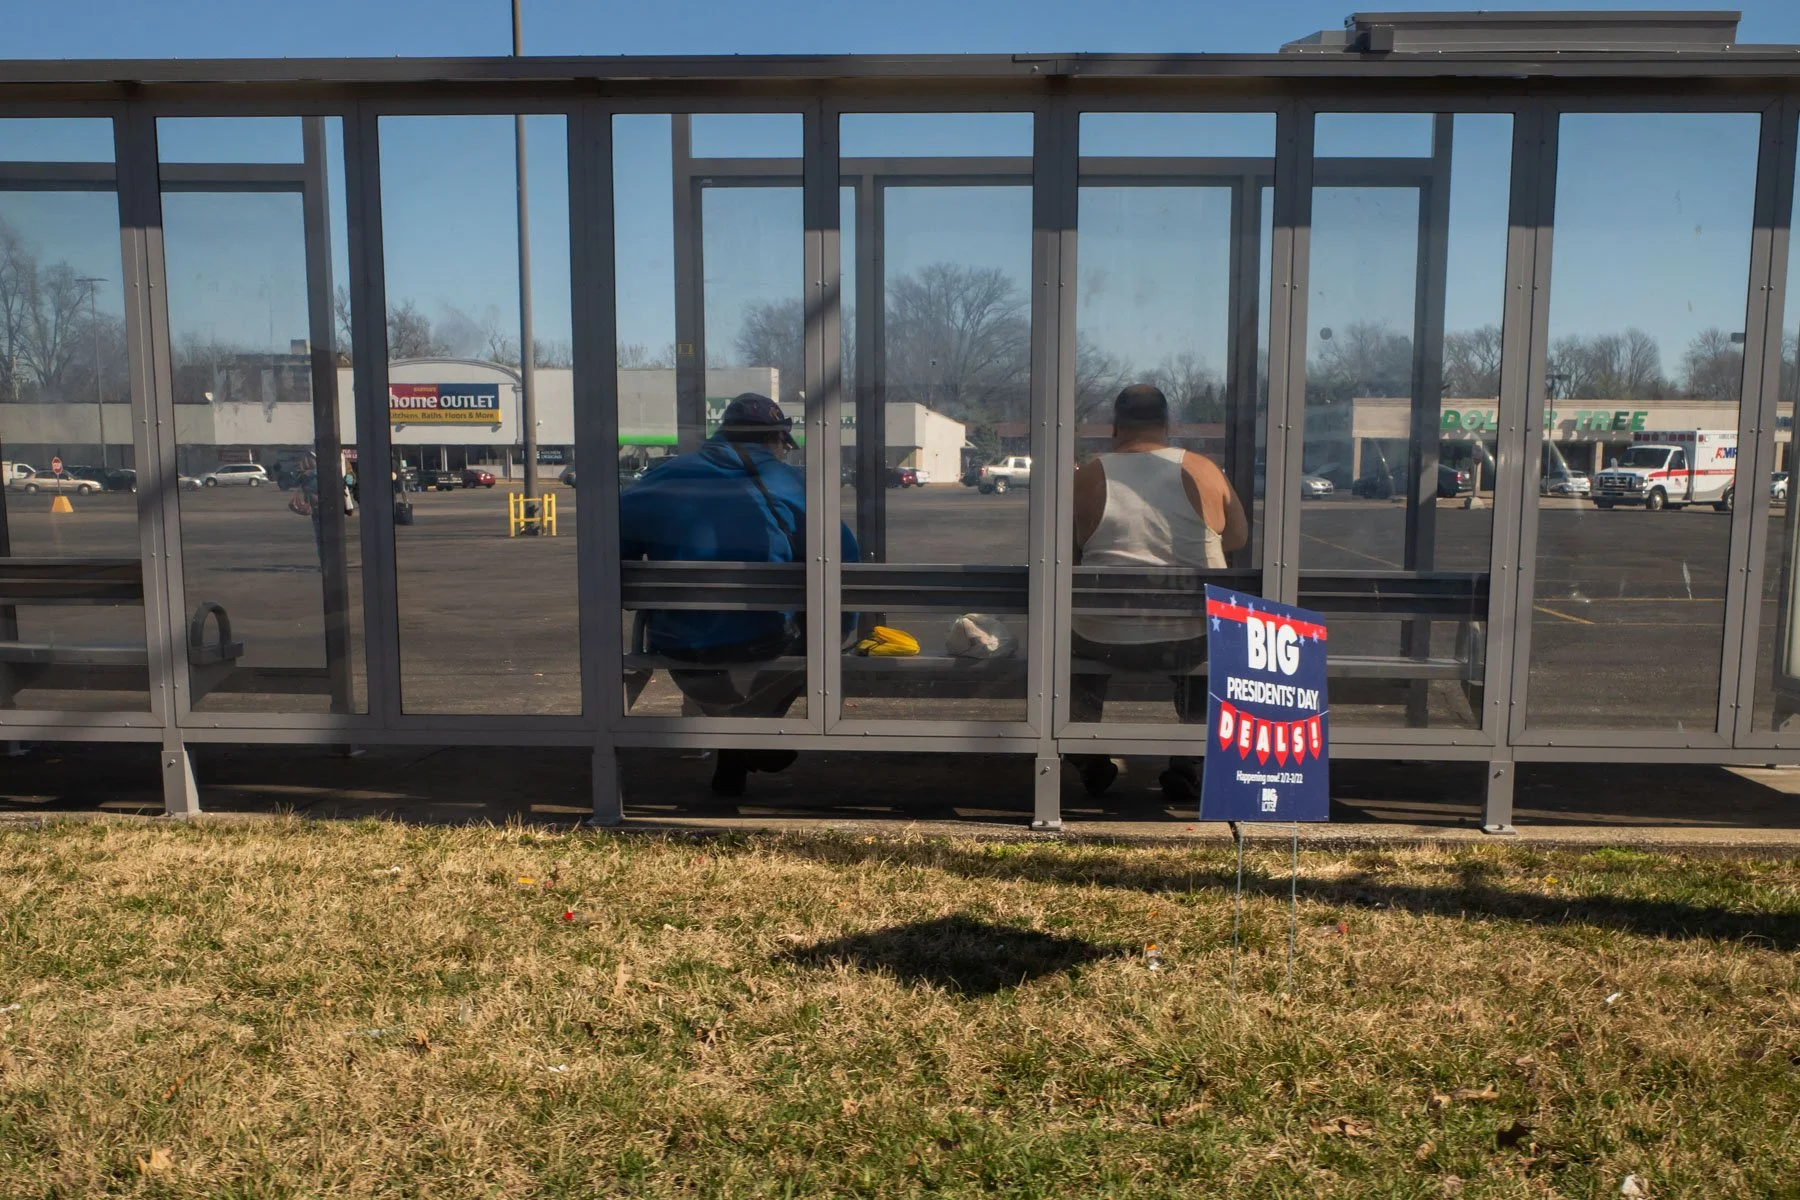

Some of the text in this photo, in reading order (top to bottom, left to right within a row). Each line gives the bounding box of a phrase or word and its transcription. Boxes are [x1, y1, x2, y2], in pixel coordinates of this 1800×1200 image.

[389, 387, 495, 408] home OUTLET
[391, 411, 419, 420] itchens,
[1440, 409, 1648, 432] DOLR TREE
[1246, 616, 1300, 676] BIG
[1227, 676, 1319, 711] PRESIDENTS' DAY
[1219, 710, 1319, 753] DEALS!
[1236, 769, 1267, 785] Happening
